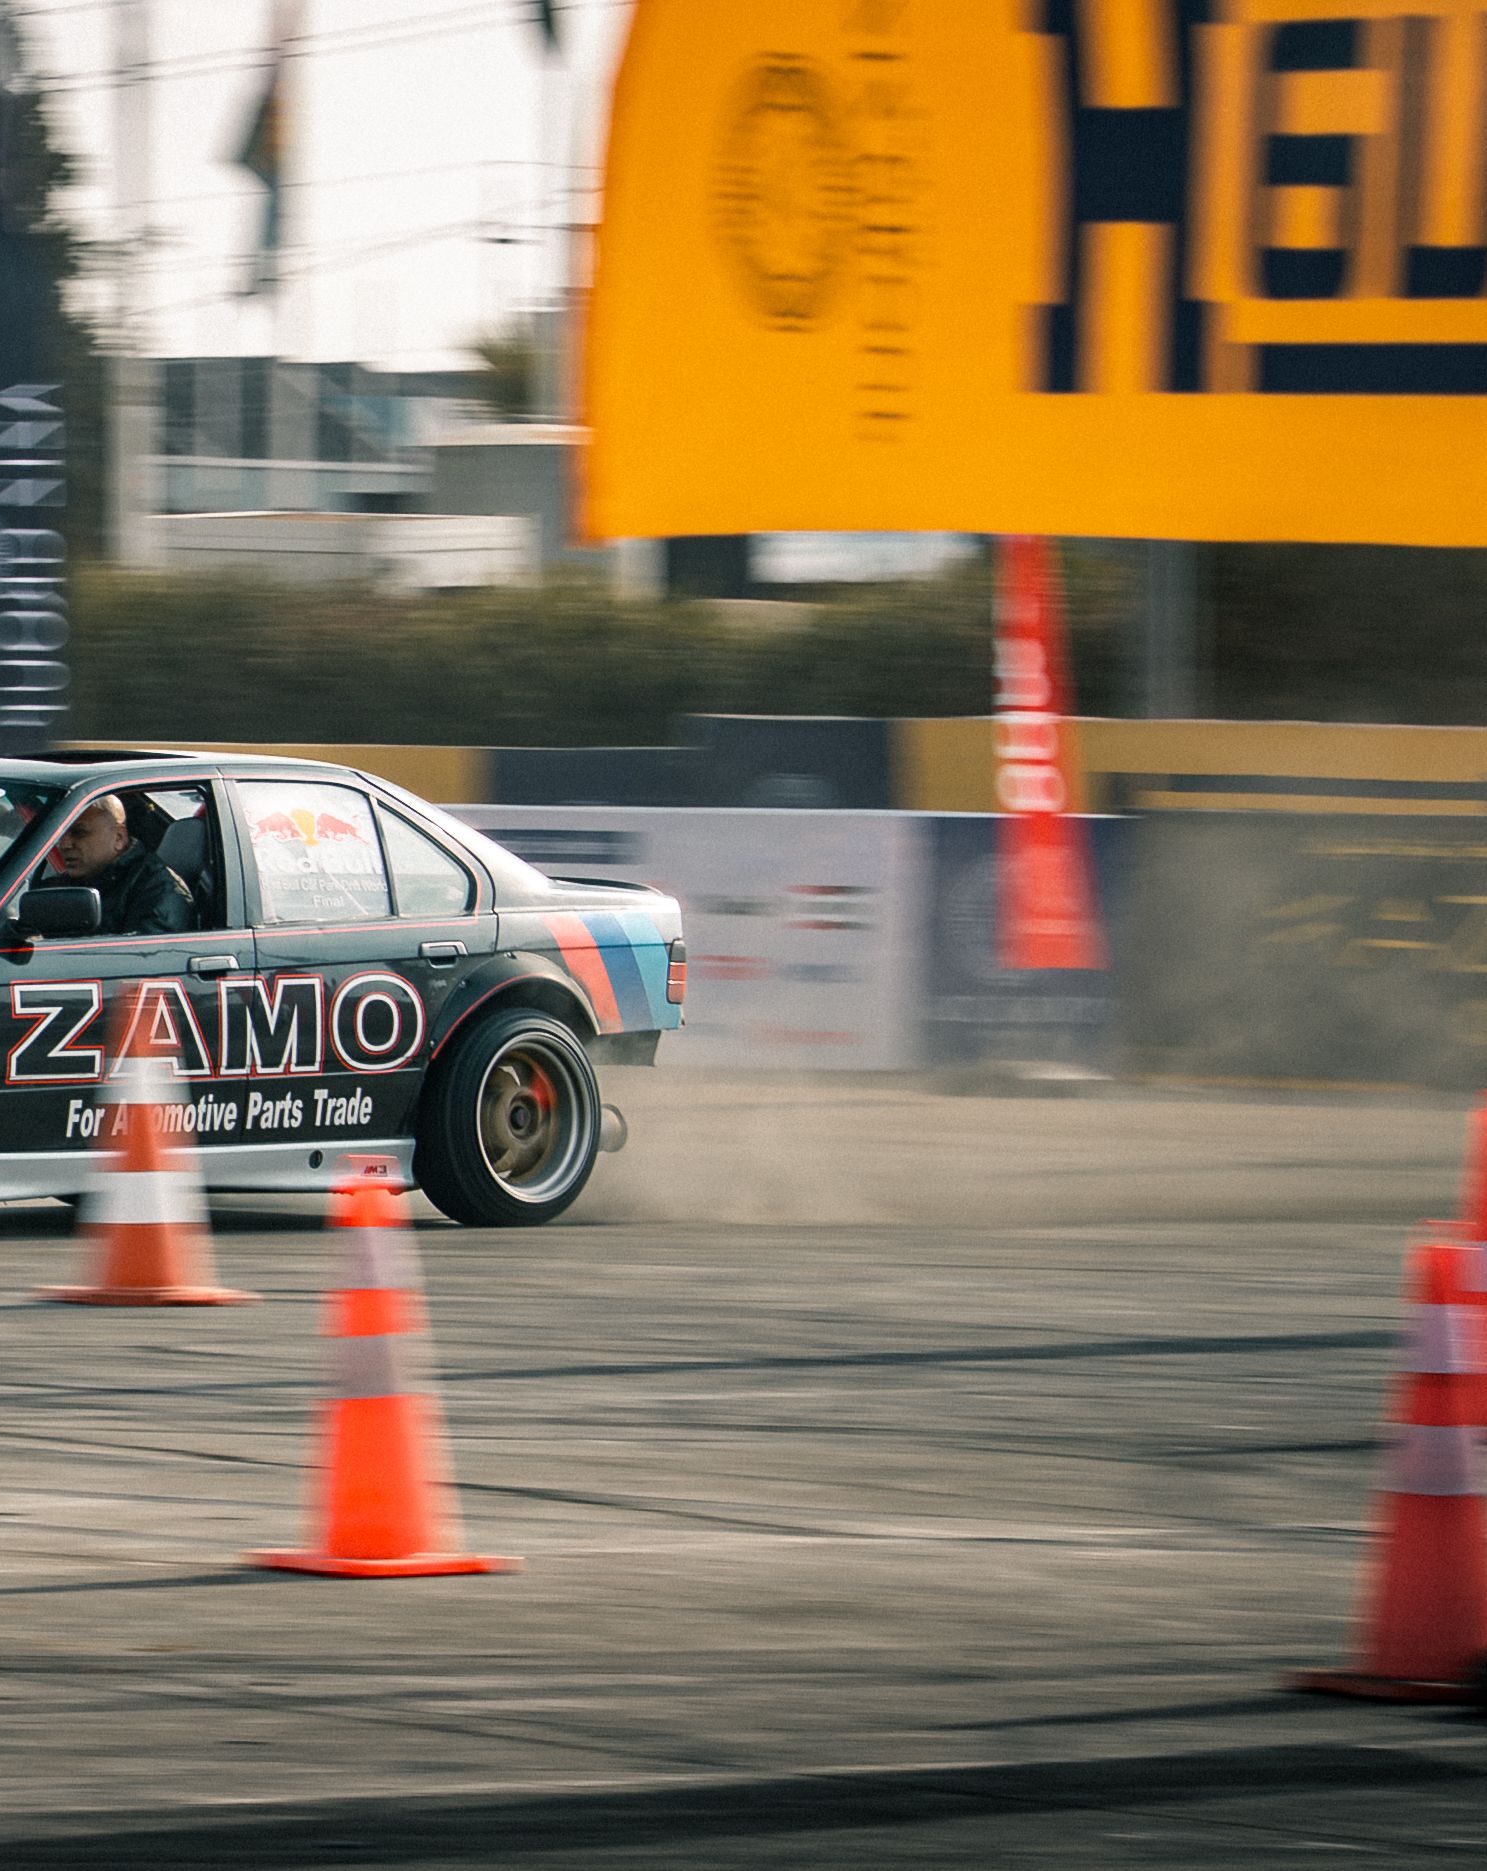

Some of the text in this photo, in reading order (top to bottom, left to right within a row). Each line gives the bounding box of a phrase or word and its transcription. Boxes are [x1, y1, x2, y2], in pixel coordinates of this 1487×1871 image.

[313, 894, 345, 908] Final
[6, 971, 426, 1085] ZAMO
[66, 1087, 373, 1138] For Aomotive Parts Trade
